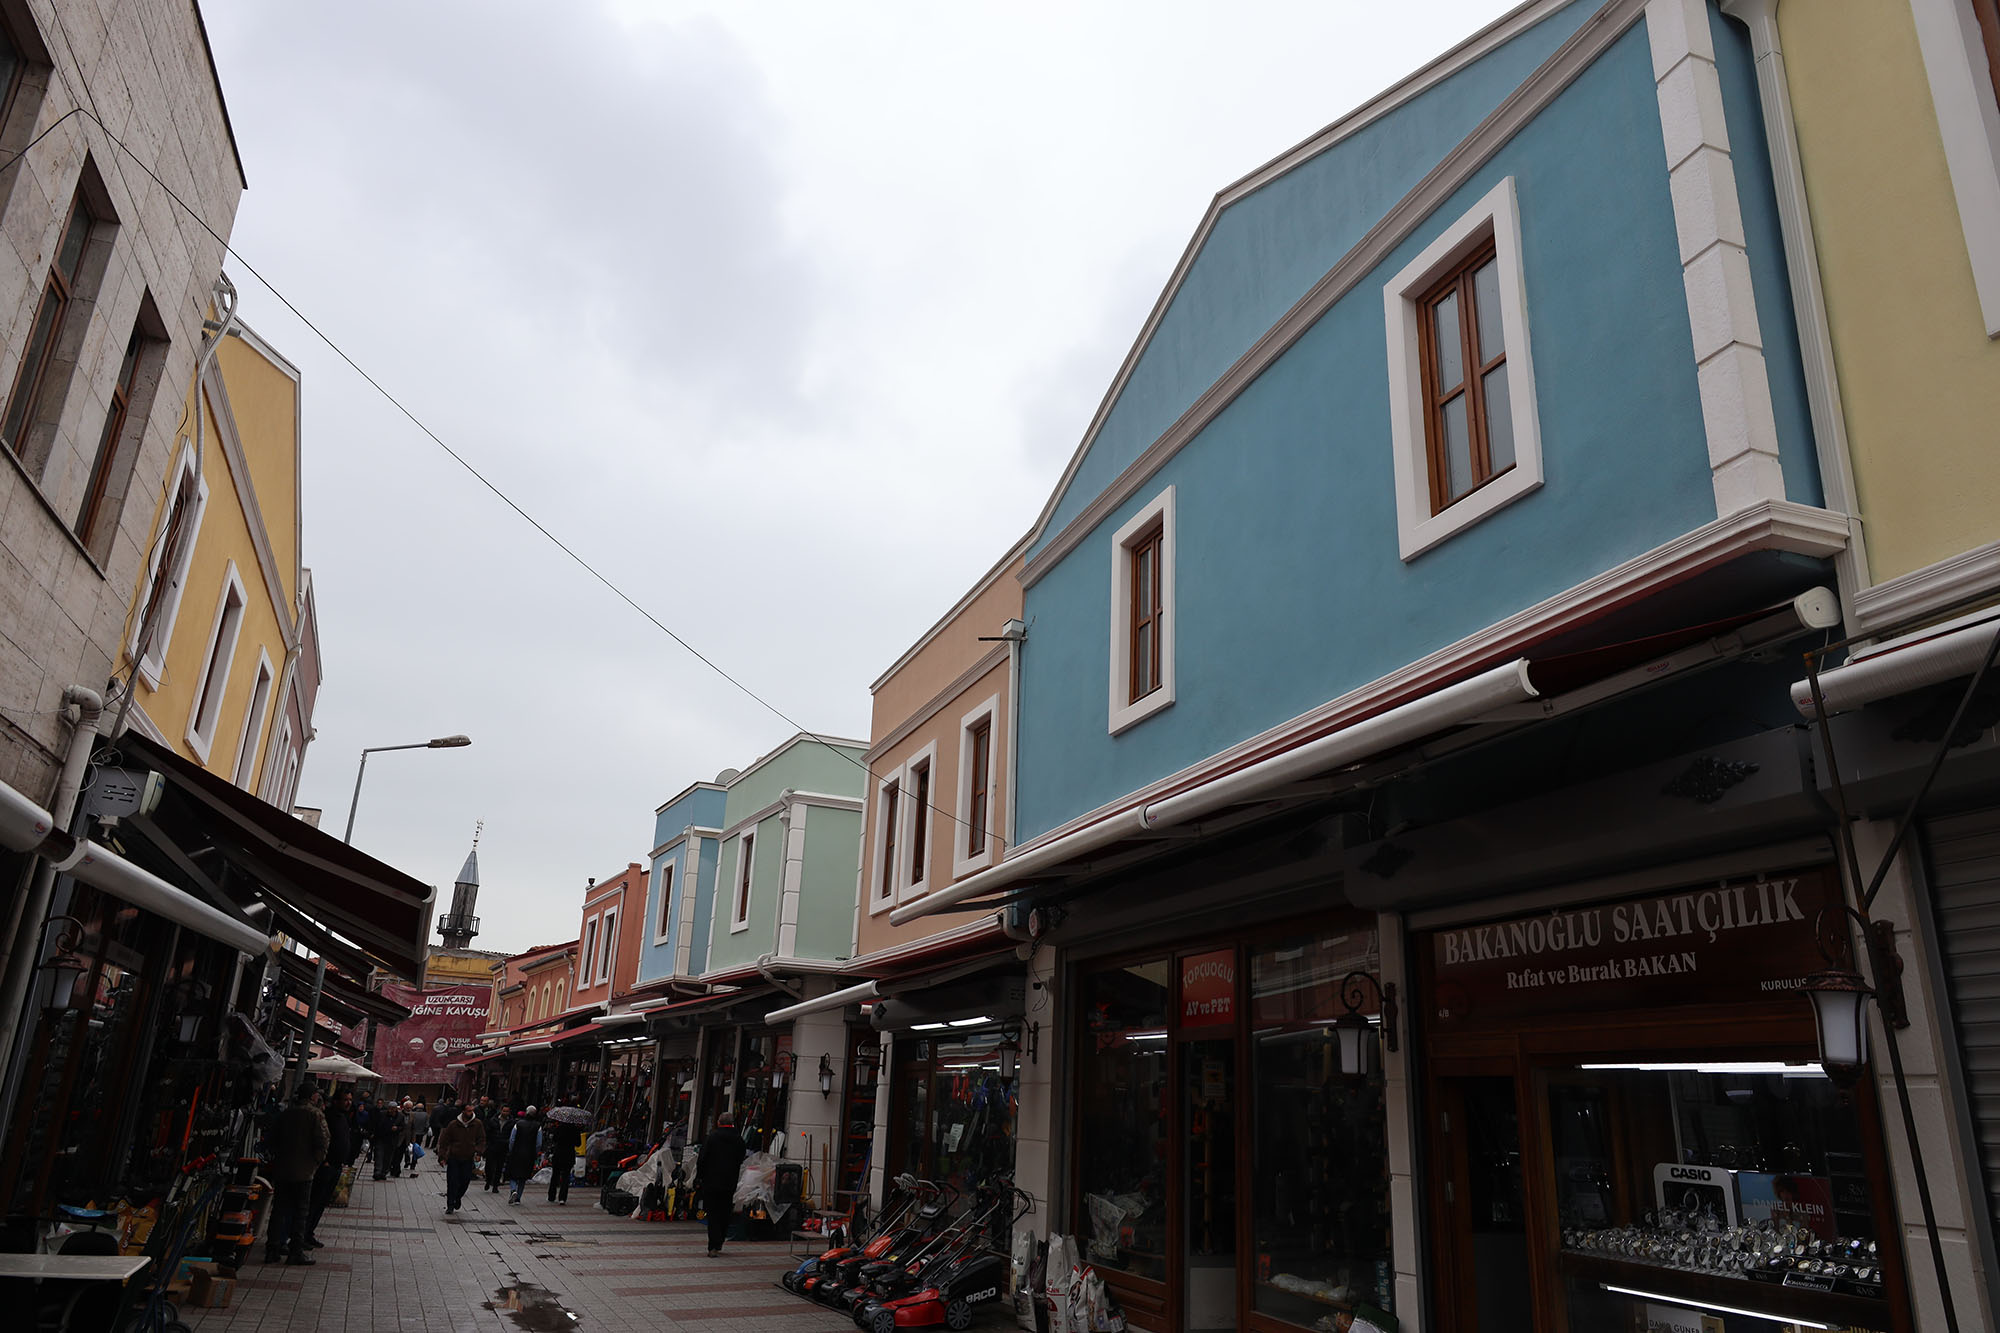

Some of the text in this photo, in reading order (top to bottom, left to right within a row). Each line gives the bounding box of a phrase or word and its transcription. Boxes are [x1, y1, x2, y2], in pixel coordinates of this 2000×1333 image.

[1443, 874, 1805, 966] BAKANOĞLU SAATÇİLİK
[1182, 959, 1235, 989] TOPÇUOĞLU
[1506, 951, 1697, 990] Rıfat ve Burak BAKAN
[1186, 997, 1231, 1016] AV ve PET
[1671, 1167, 1711, 1181] CASIO
[1752, 1198, 1824, 1215] DANIEL KLEIN
